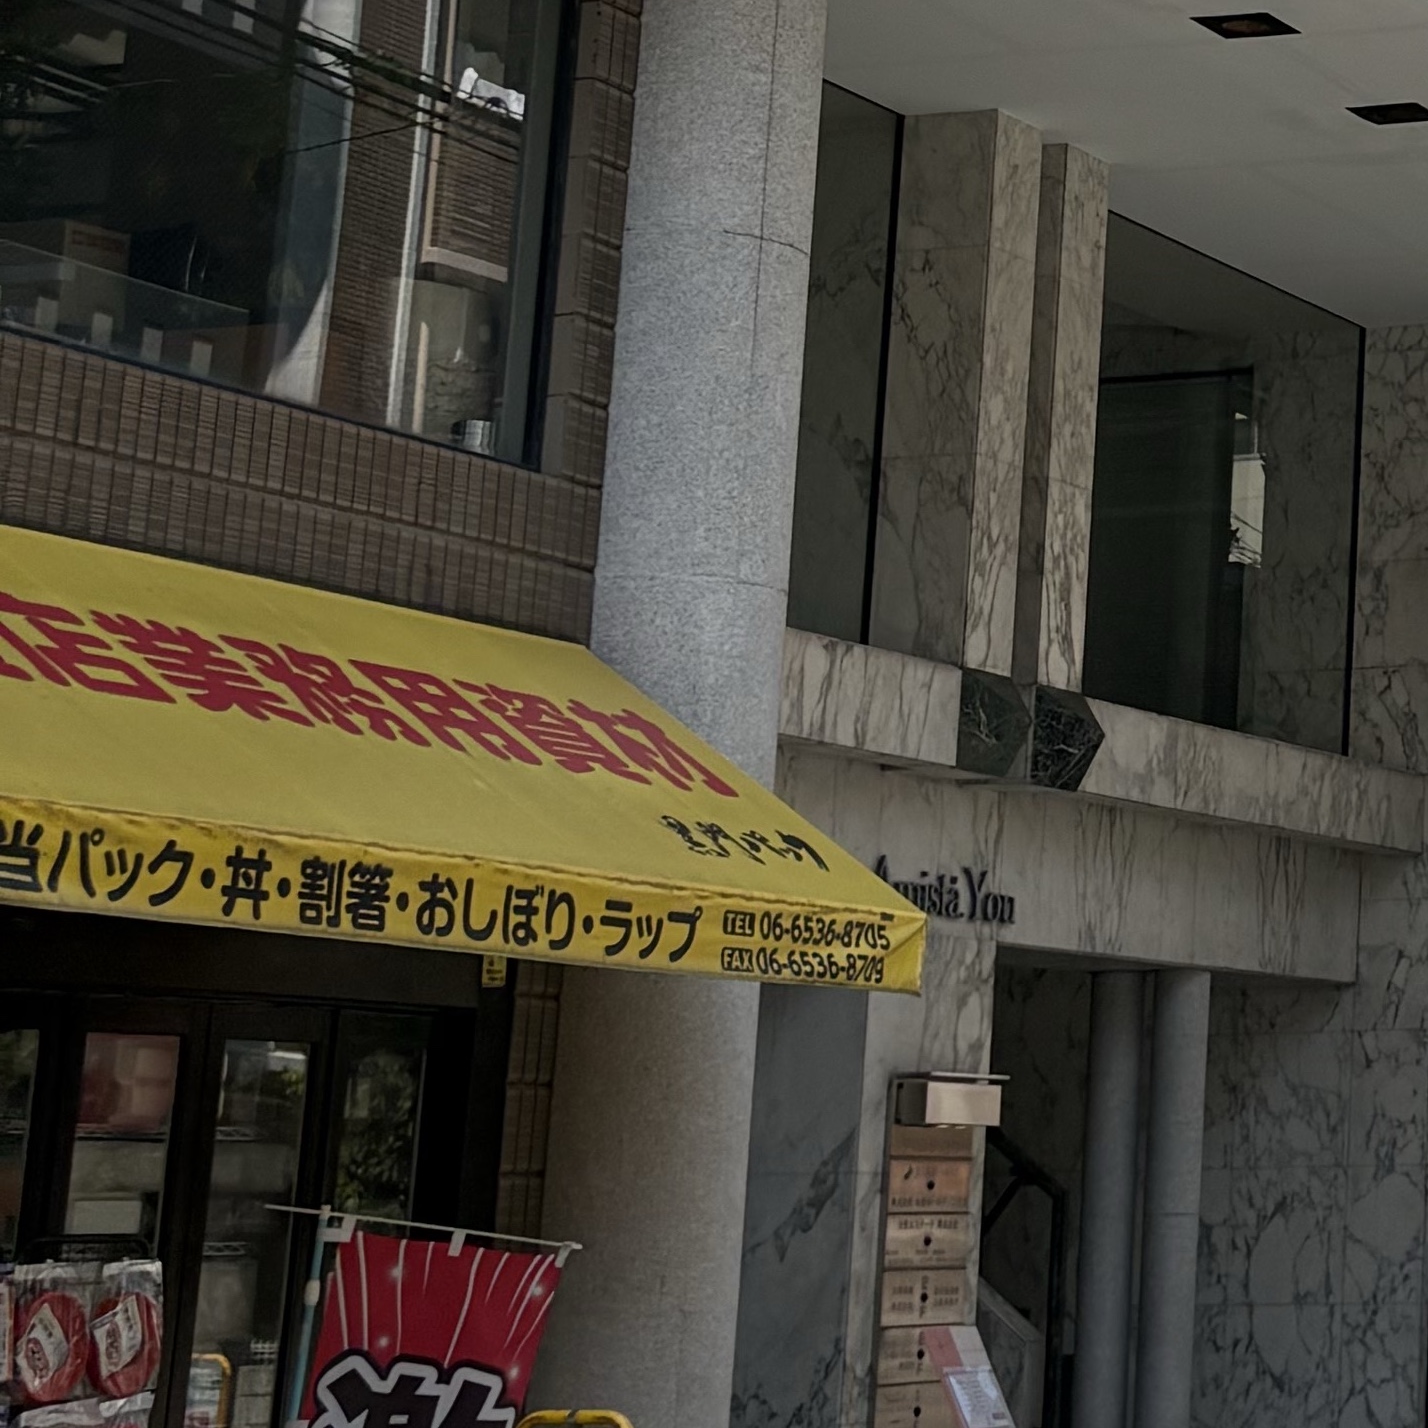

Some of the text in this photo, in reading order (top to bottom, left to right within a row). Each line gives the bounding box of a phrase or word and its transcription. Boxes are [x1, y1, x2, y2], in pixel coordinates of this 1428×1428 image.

[0, 591, 741, 799] 店業務用資材
[963, 866, 1016, 925] You
[723, 909, 892, 950] TEL 06-6536-8705
[721, 947, 886, 984] FAX 06-6536-8709
